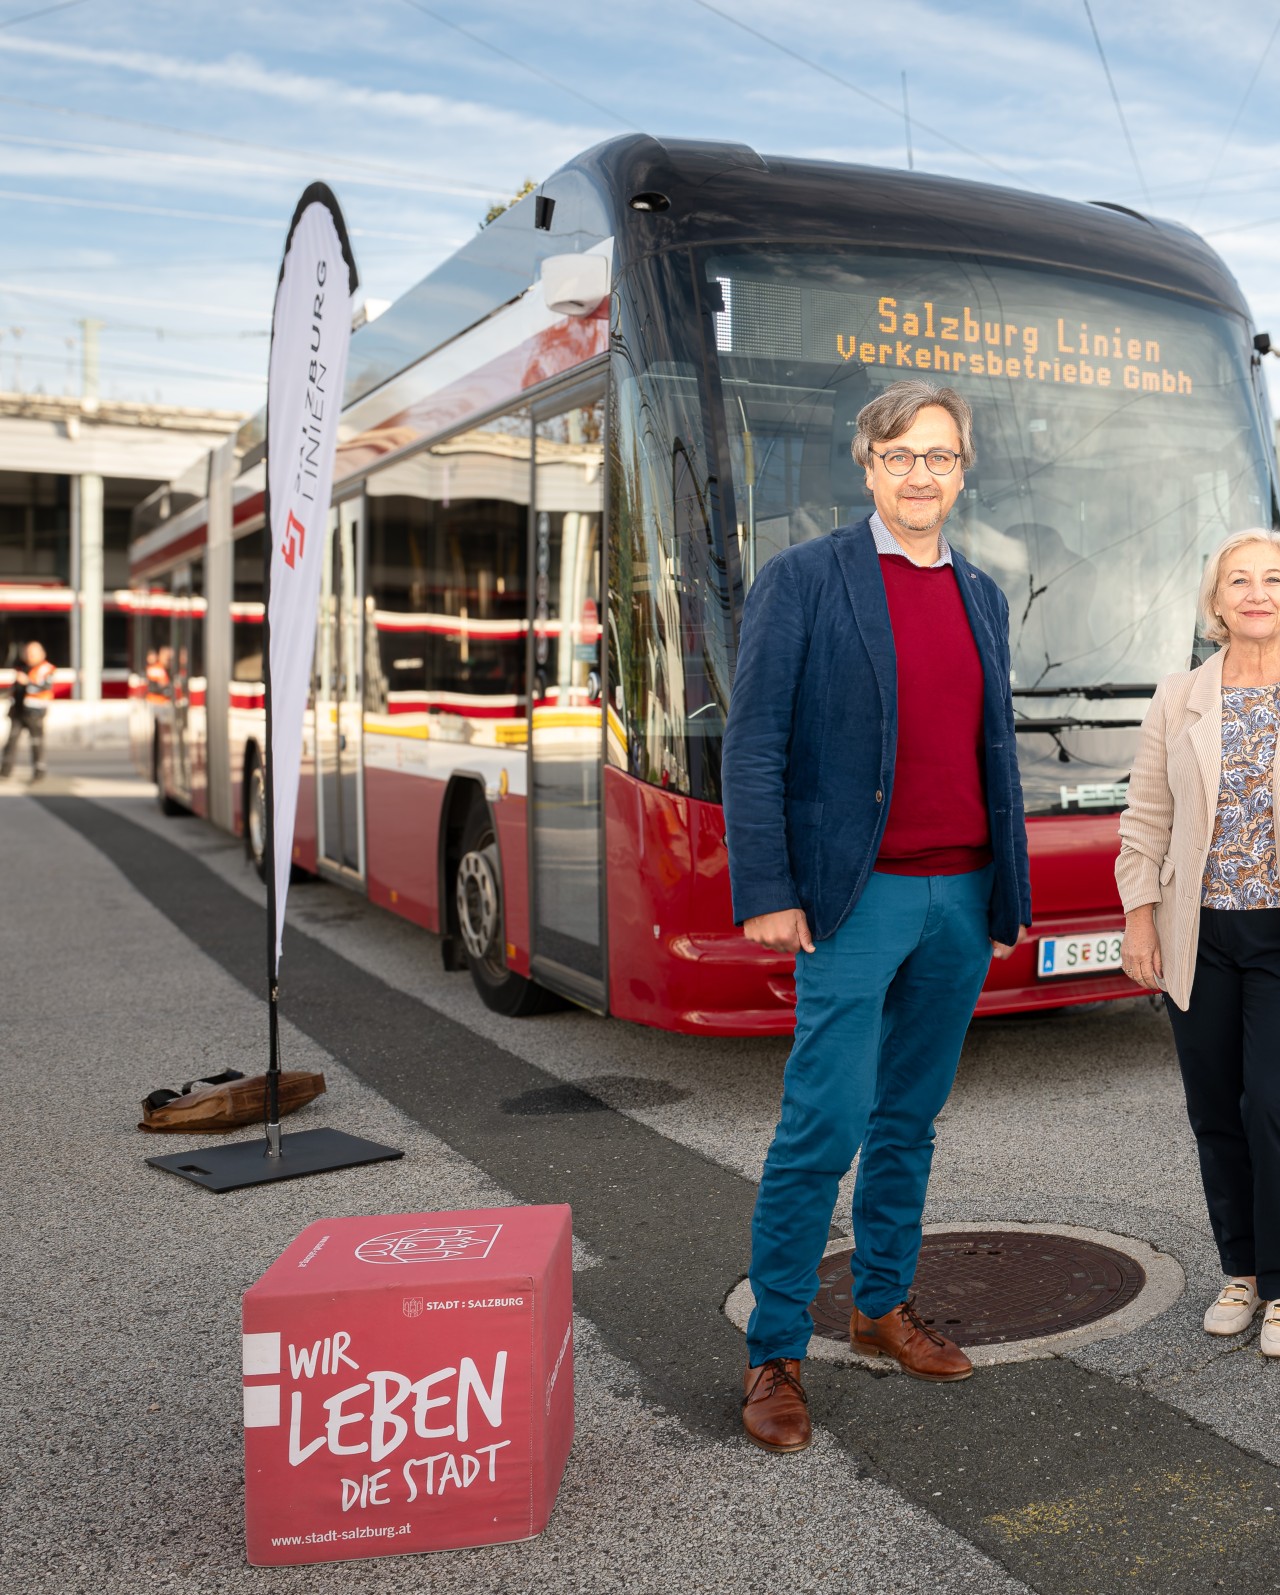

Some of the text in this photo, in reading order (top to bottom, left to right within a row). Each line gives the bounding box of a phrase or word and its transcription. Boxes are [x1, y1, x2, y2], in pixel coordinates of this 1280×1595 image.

[878, 296, 1161, 363] Salzburg Linien
[295, 260, 327, 494] ZBURG
[836, 334, 1193, 395] Verkehrsbetriebe Gmbh
[302, 363, 328, 501] LINIEN
[426, 1300, 460, 1311] STADT
[467, 1297, 524, 1309] SALZBURG
[288, 1331, 360, 1380] WIR
[288, 1350, 508, 1467] LEBEN
[340, 1439, 511, 1512] DIE STADT
[271, 1522, 412, 1547] www.stadt-salzburg.at
